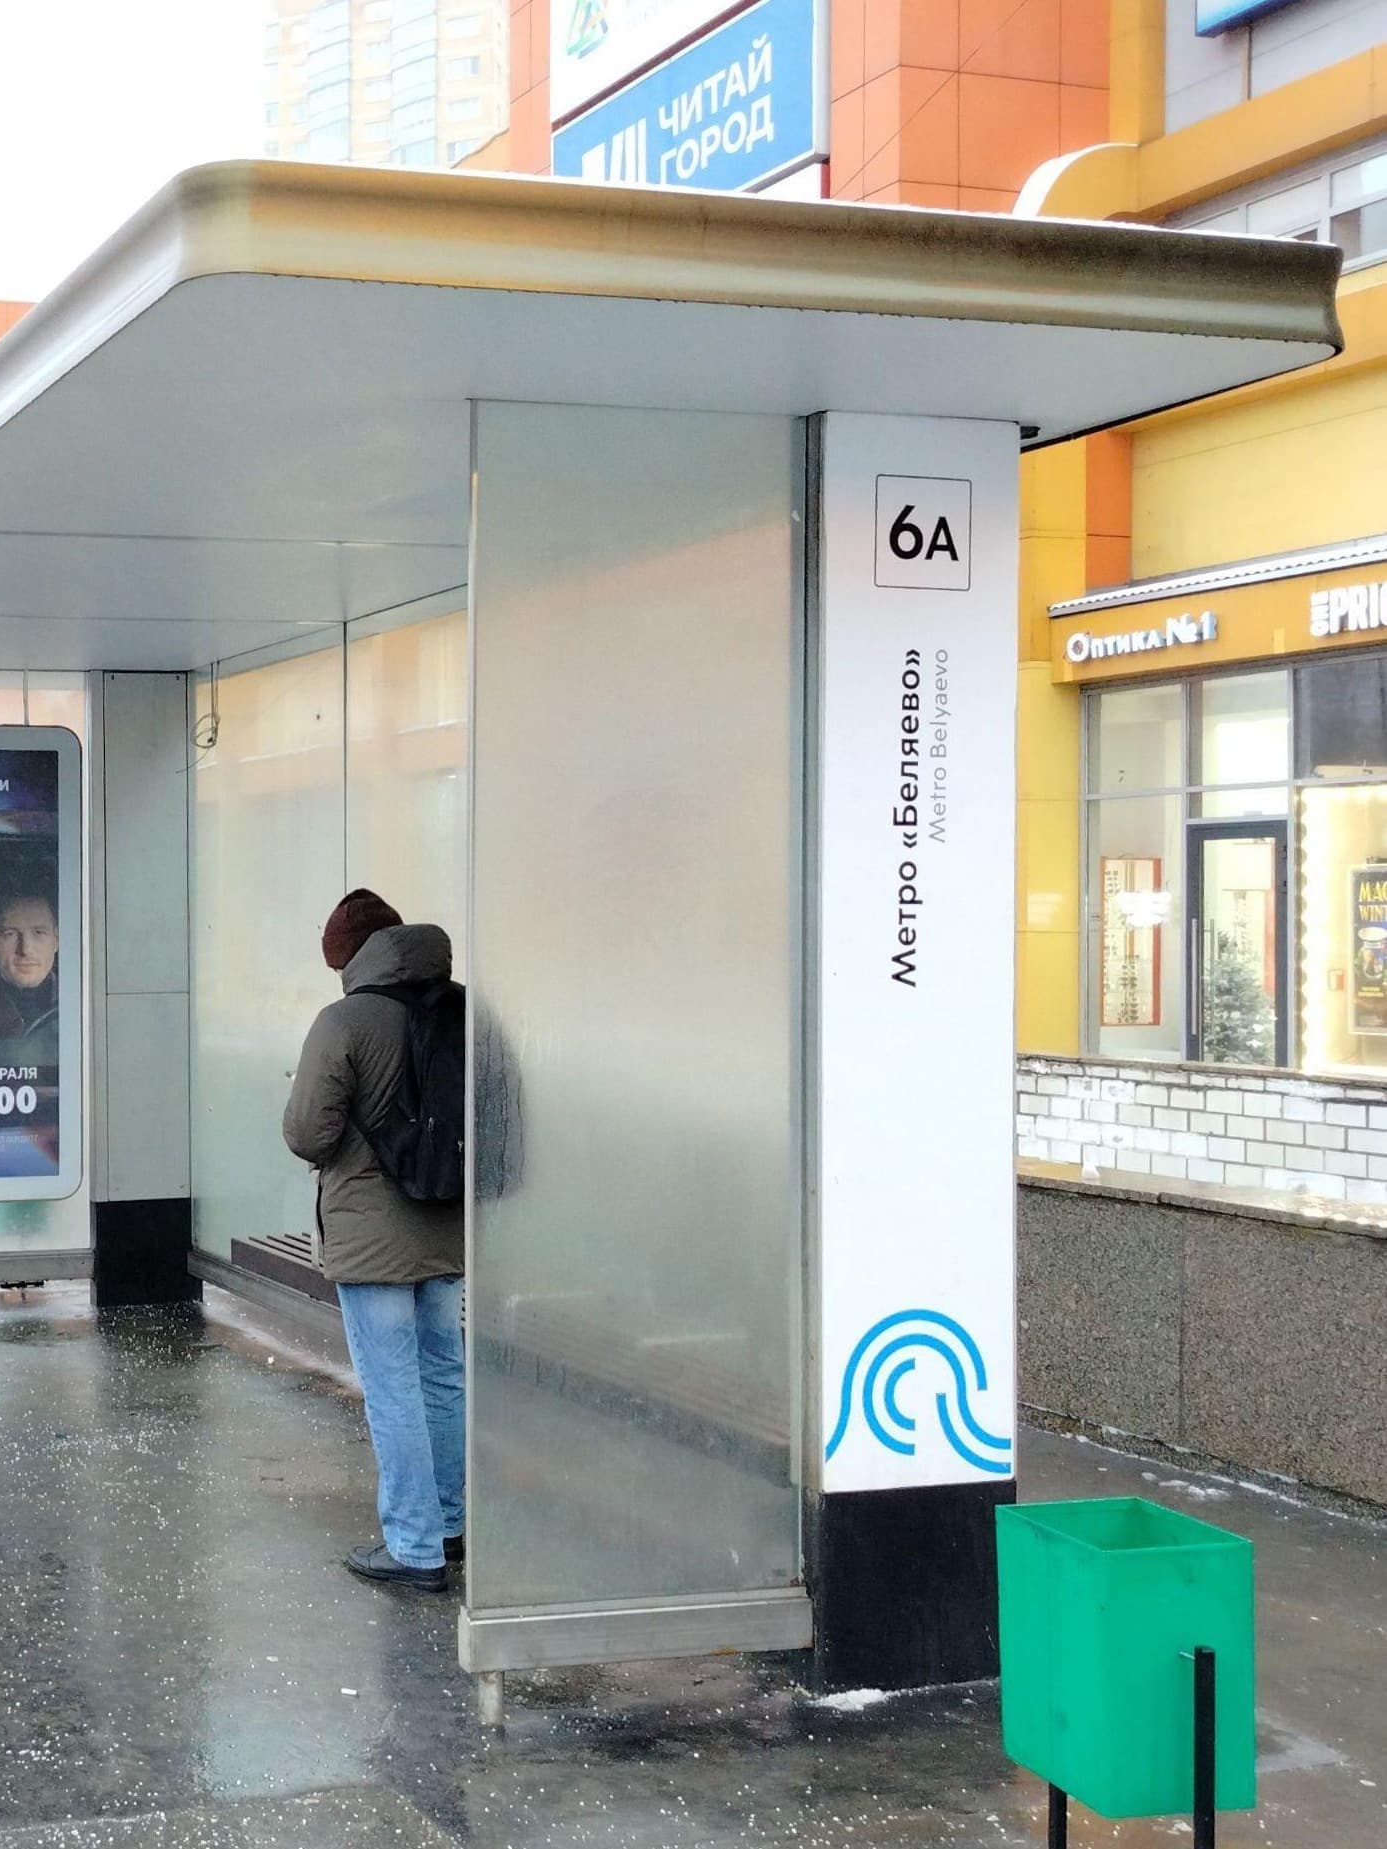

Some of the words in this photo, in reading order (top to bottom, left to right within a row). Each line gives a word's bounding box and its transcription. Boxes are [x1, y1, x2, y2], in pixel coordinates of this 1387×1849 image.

[659, 33, 772, 136] ЧИТАЙ
[660, 94, 775, 184] ГОРОД
[893, 649, 920, 848] «Беляево»
[929, 649, 951, 758] Belyaevo
[928, 767, 947, 843] Metro
[891, 861, 923, 988] Метро
